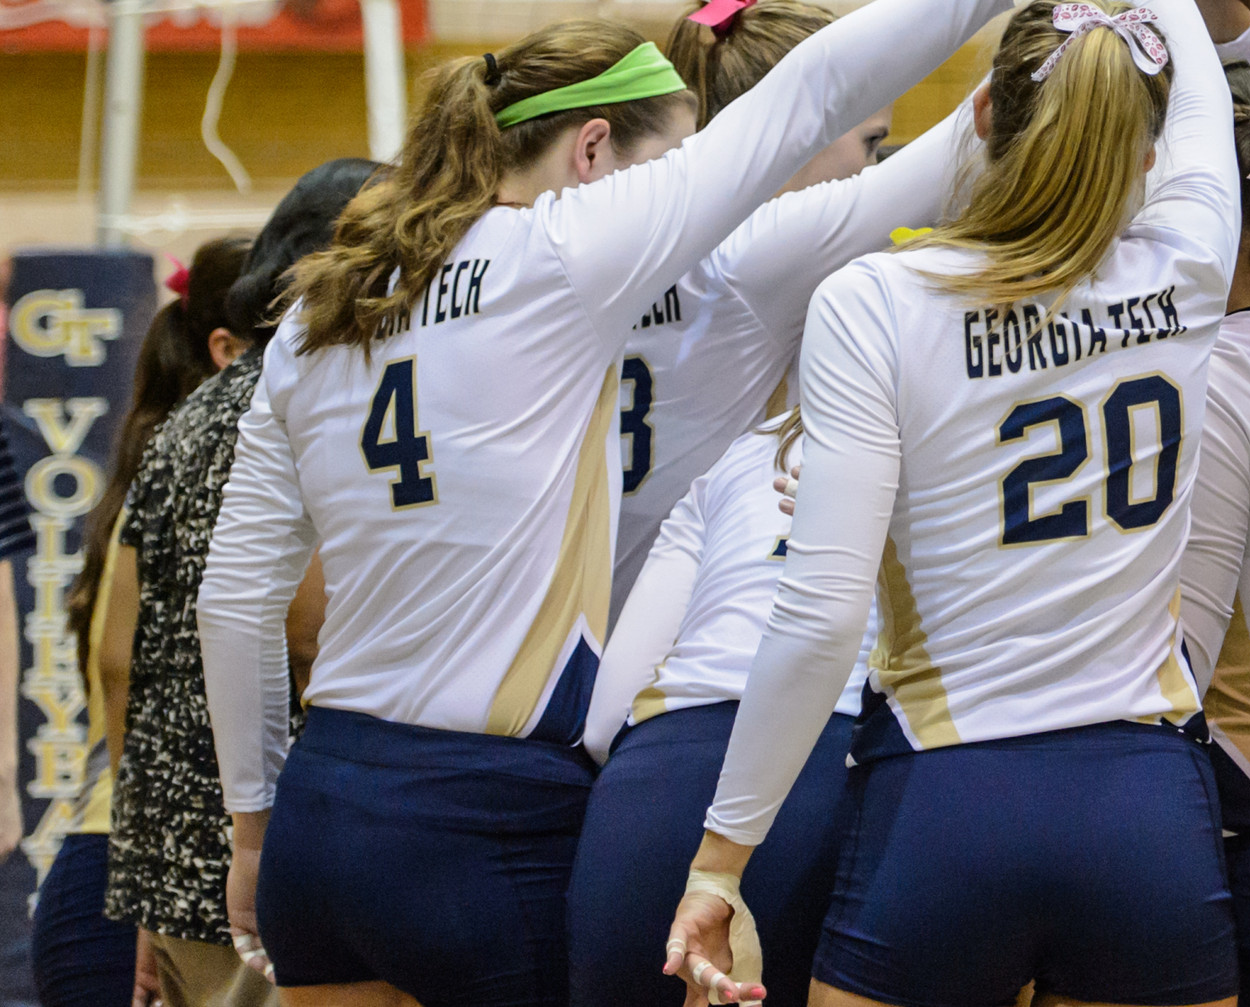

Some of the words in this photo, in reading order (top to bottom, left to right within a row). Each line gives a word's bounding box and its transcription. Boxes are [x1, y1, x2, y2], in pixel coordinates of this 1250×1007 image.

[964, 303, 1108, 380] GEORGIA
[1107, 285, 1189, 348] TECH
[358, 354, 440, 513] 4
[994, 369, 1185, 550] 20
